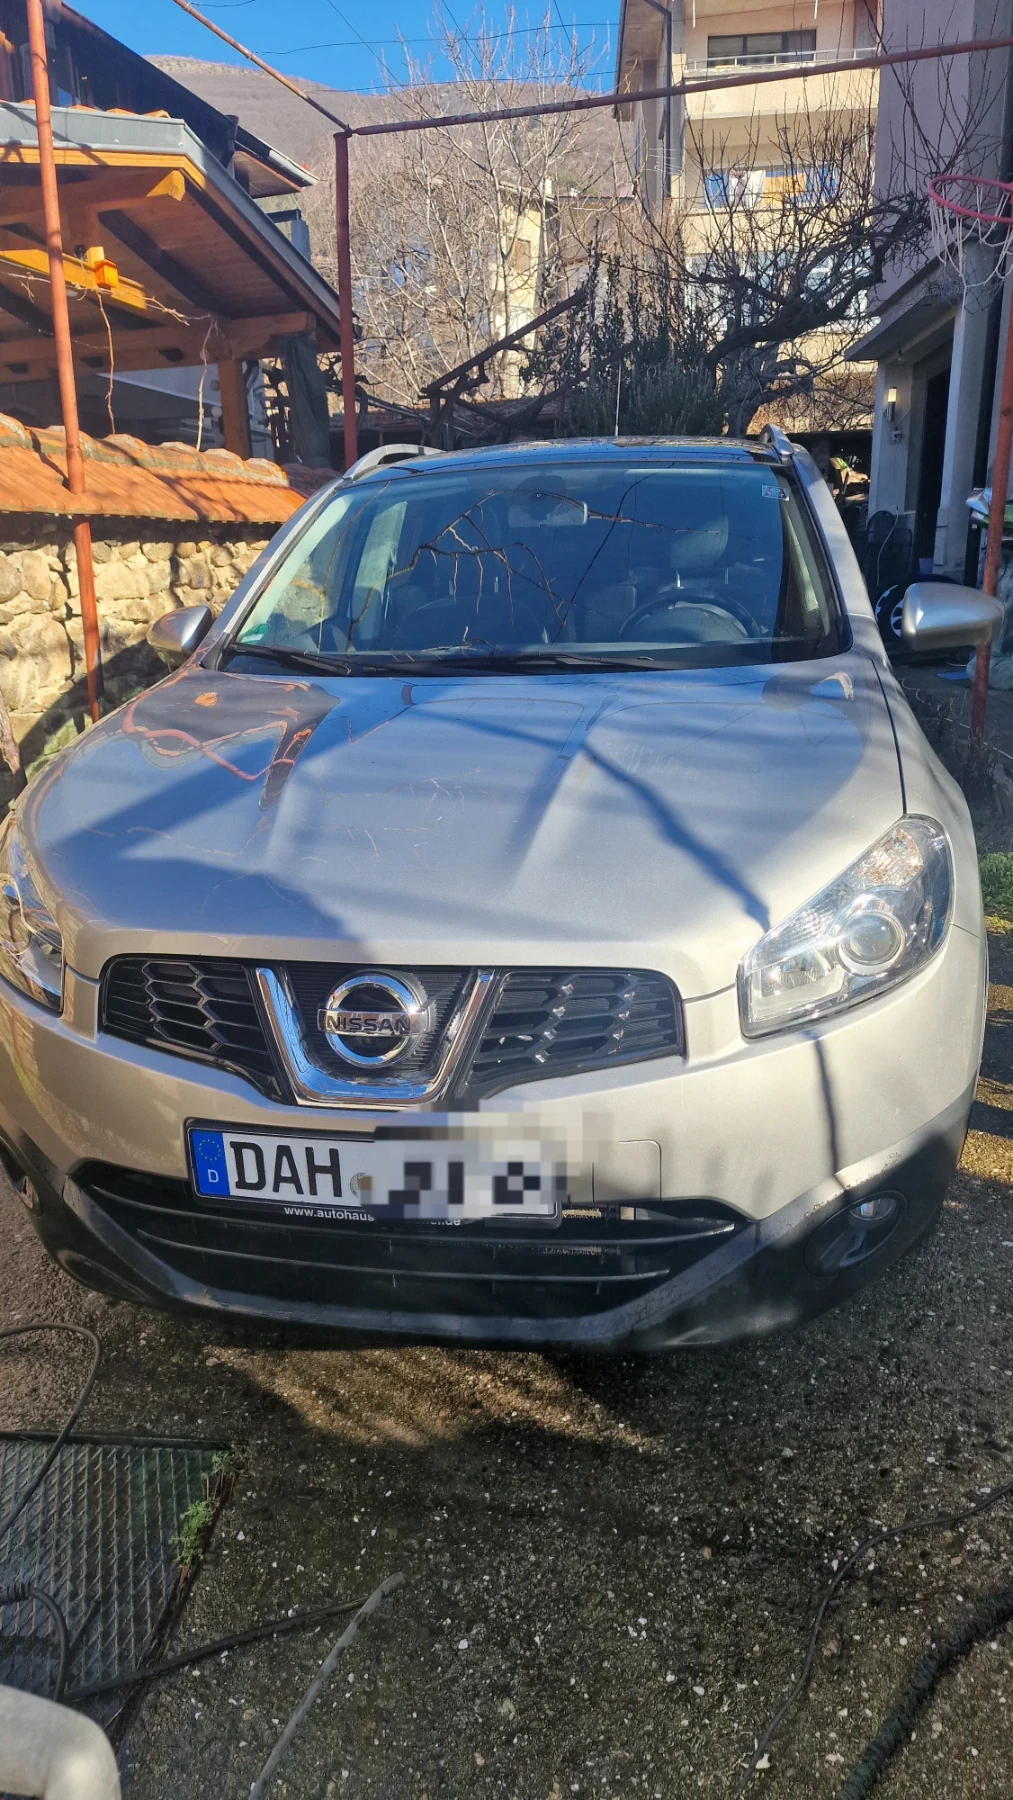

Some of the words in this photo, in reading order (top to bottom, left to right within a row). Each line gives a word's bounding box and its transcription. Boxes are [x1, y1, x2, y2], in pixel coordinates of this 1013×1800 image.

[325, 1015, 411, 1033] NISSAN
[207, 1169, 219, 1183] D
[230, 1141, 342, 1197] DAH
